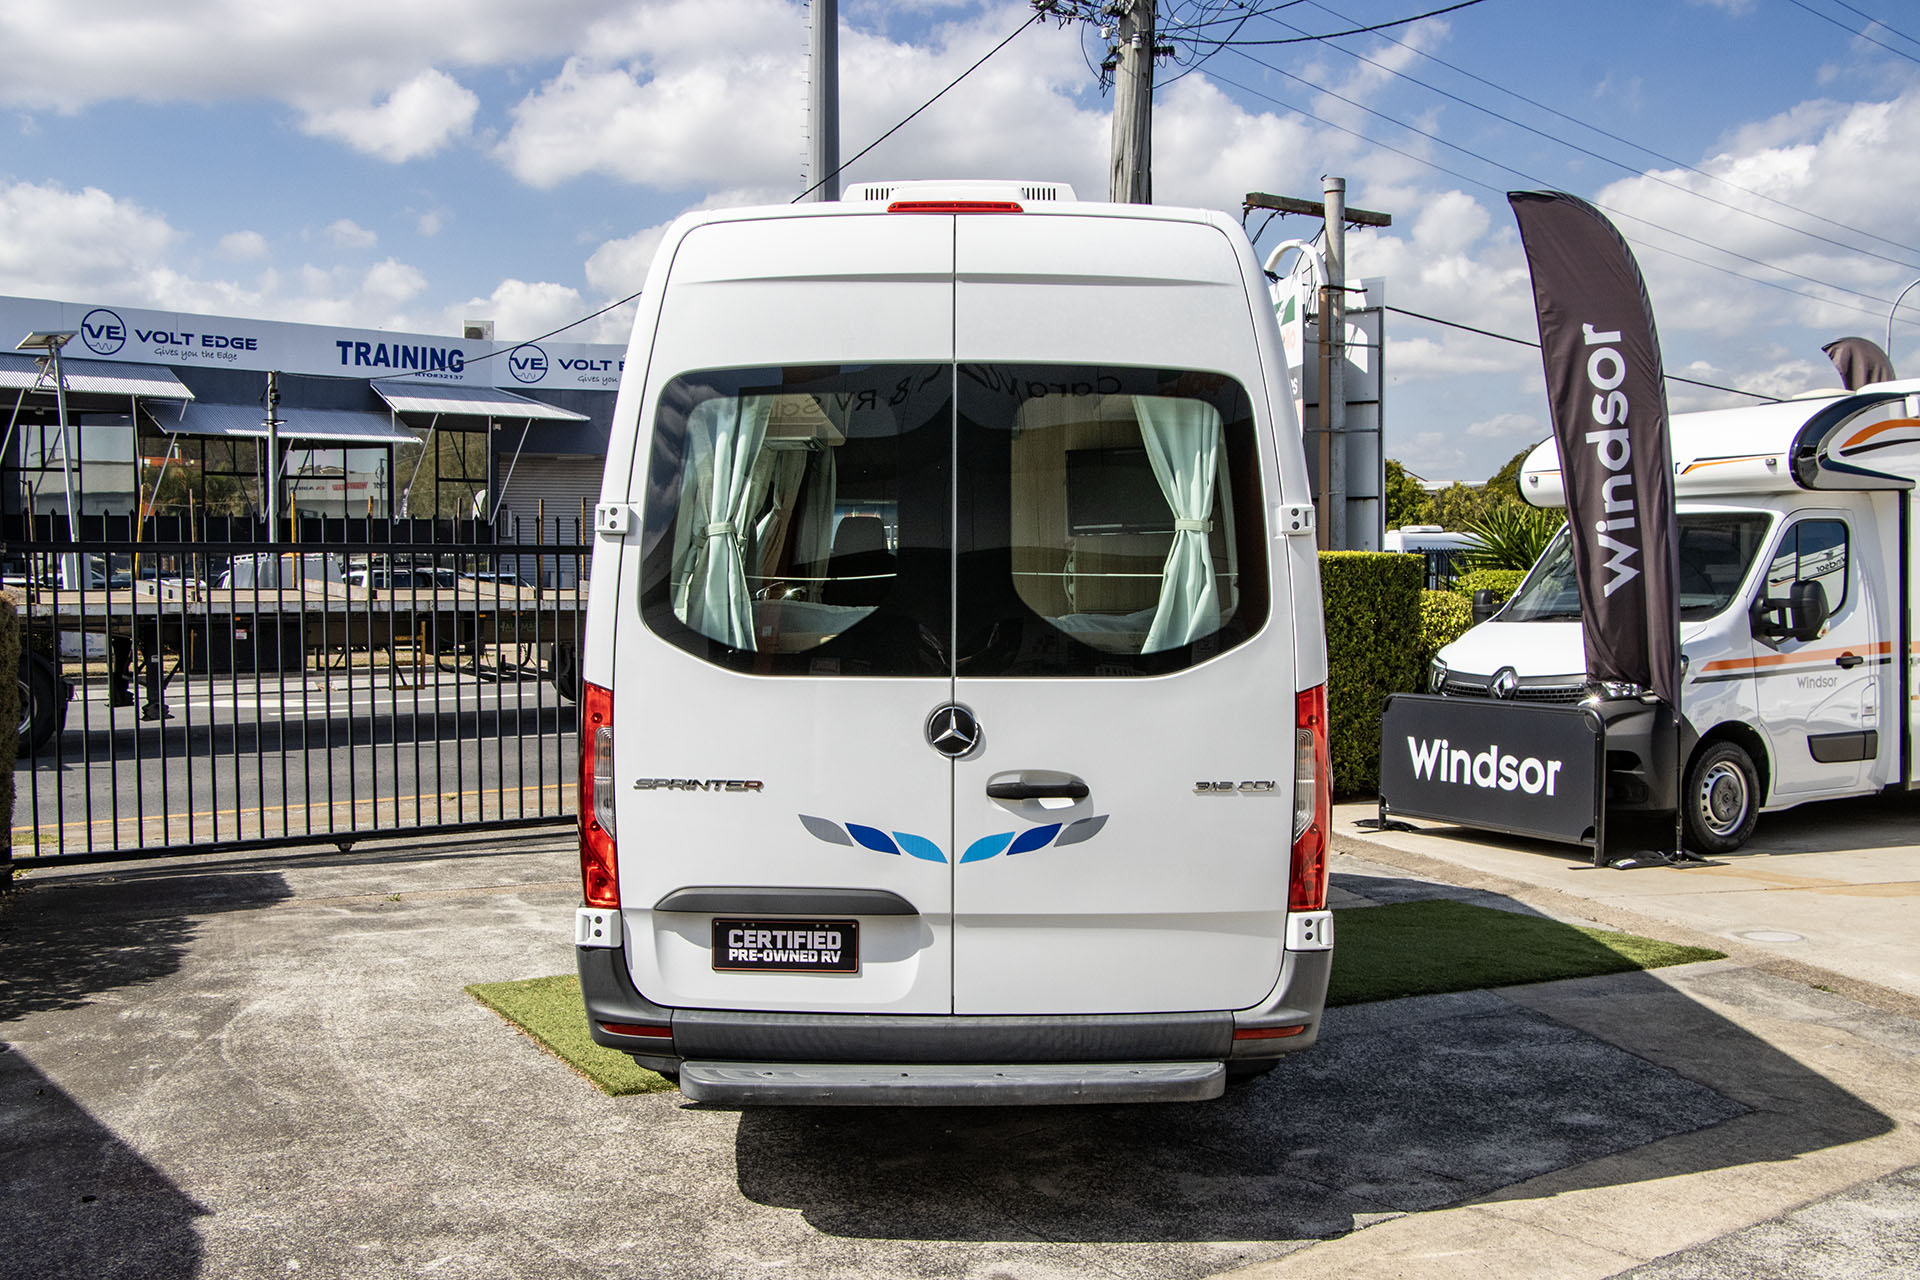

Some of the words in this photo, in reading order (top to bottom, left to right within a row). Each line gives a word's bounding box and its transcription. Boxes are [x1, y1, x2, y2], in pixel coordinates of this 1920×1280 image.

[83, 323, 125, 341] VE
[135, 329, 195, 346] VOLT
[201, 334, 258, 351] EDGE
[154, 346, 179, 357] Gives
[180, 349, 199, 361] you
[201, 350, 214, 359] the
[216, 351, 238, 361] Edge
[336, 340, 465, 373] TRAINING
[510, 357, 548, 370] VE
[558, 358, 613, 372] VOLT
[577, 374, 600, 383] Gives
[601, 376, 618, 386] you
[1582, 322, 1640, 599] Windsor
[1796, 676, 1838, 690] Windsor
[1407, 736, 1563, 797] Windsor
[633, 778, 764, 793] SPRINTER
[1236, 780, 1276, 793] CDI
[728, 929, 842, 950] CERTIFIED
[728, 948, 818, 963] PRE-OWNED
[820, 950, 841, 963] RV
